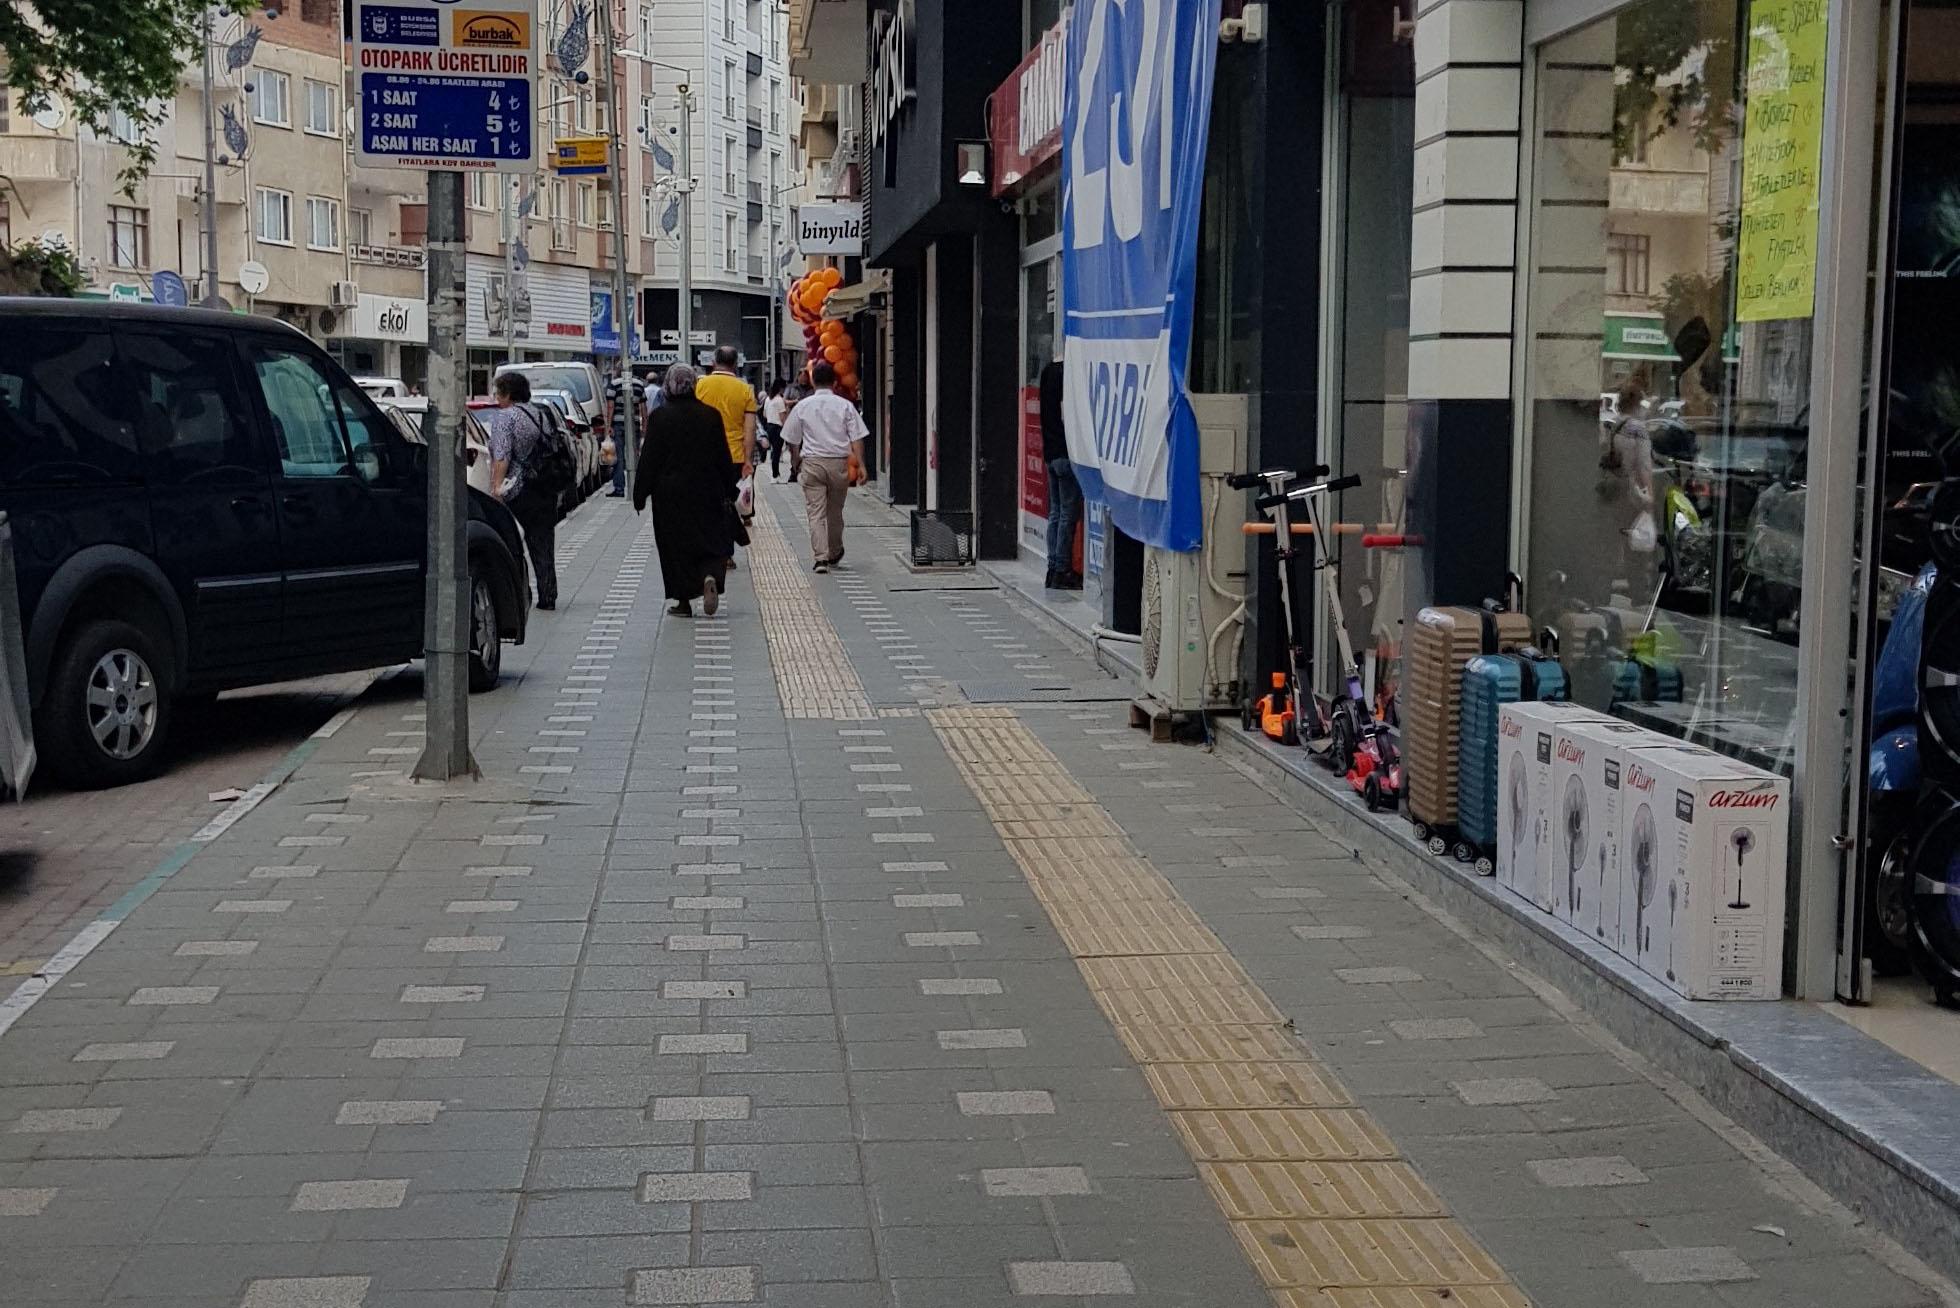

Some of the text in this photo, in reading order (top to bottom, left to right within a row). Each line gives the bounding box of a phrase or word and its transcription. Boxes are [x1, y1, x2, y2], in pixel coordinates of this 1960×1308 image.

[400, 15, 437, 23] BURSA
[469, 26, 513, 40] burbak
[361, 48, 528, 74] OTOPARK ÜCRETLİDİR
[371, 90, 378, 105] 1
[383, 90, 418, 106] SAAT
[488, 90, 501, 111] 4
[371, 113, 380, 128] 2
[383, 113, 418, 129] SAAT
[486, 114, 503, 133] 5
[371, 135, 408, 153] AŞAN
[412, 136, 440, 152] HER
[442, 138, 478, 154] SAAT
[490, 137, 500, 155] 1
[1557, 738, 1585, 769] arzum
[1627, 764, 1655, 798] arzum
[1709, 790, 1779, 811] arzum
